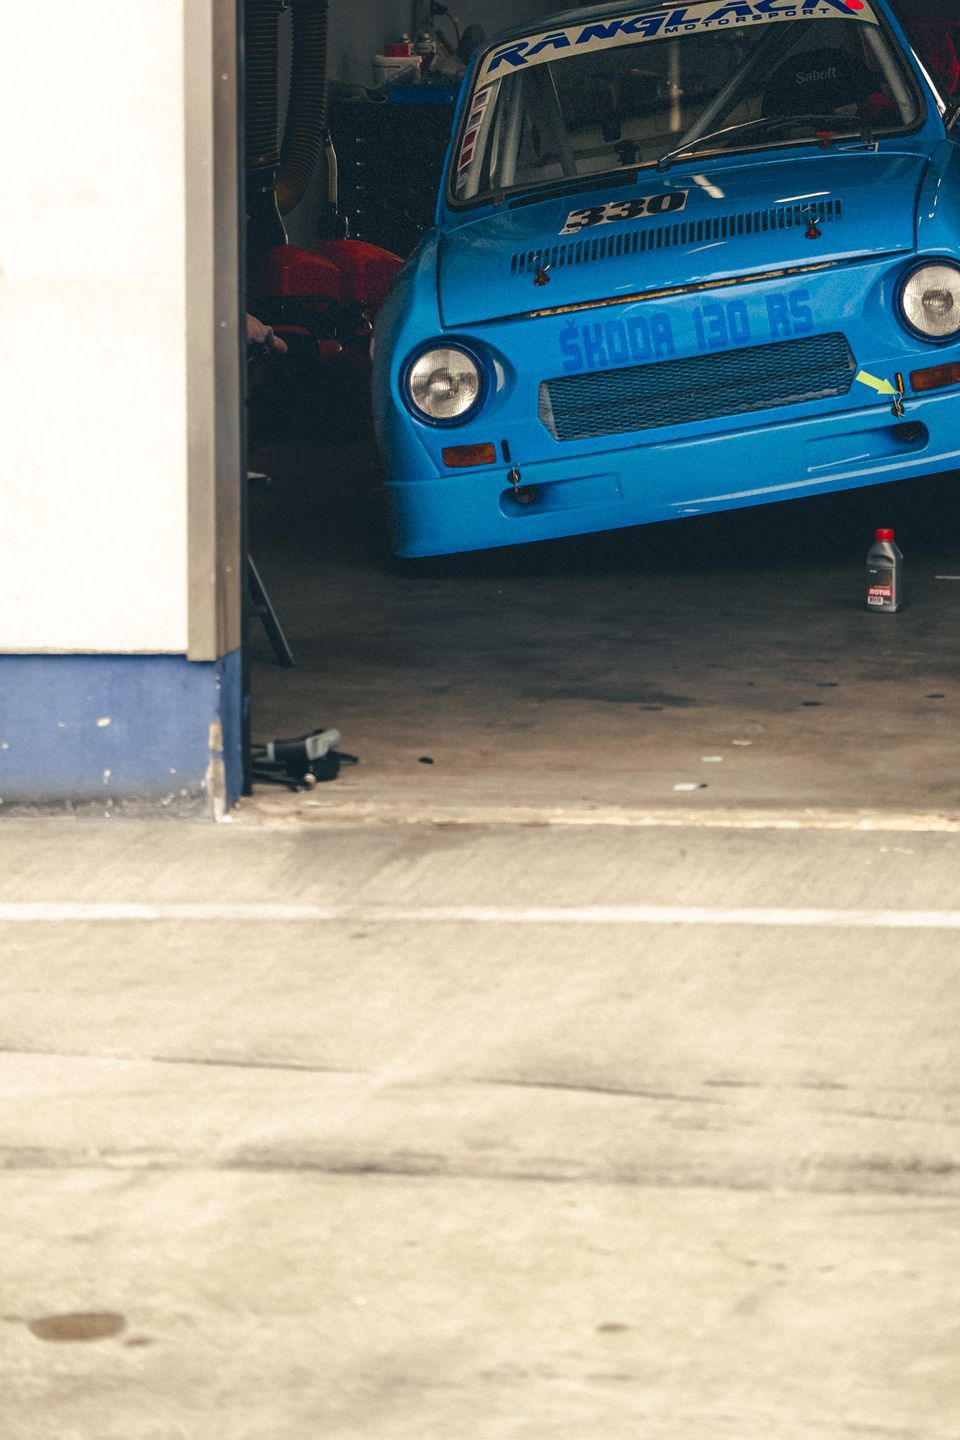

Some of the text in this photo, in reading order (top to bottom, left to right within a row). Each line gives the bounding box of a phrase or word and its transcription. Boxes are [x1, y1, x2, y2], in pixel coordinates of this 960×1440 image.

[664, 7, 831, 34] MOTORSPORT
[796, 66, 838, 85] Sabelt
[566, 192, 686, 229] 330
[559, 289, 814, 371] ŠKODA 130 RS
[868, 588, 891, 596] MOTUL
